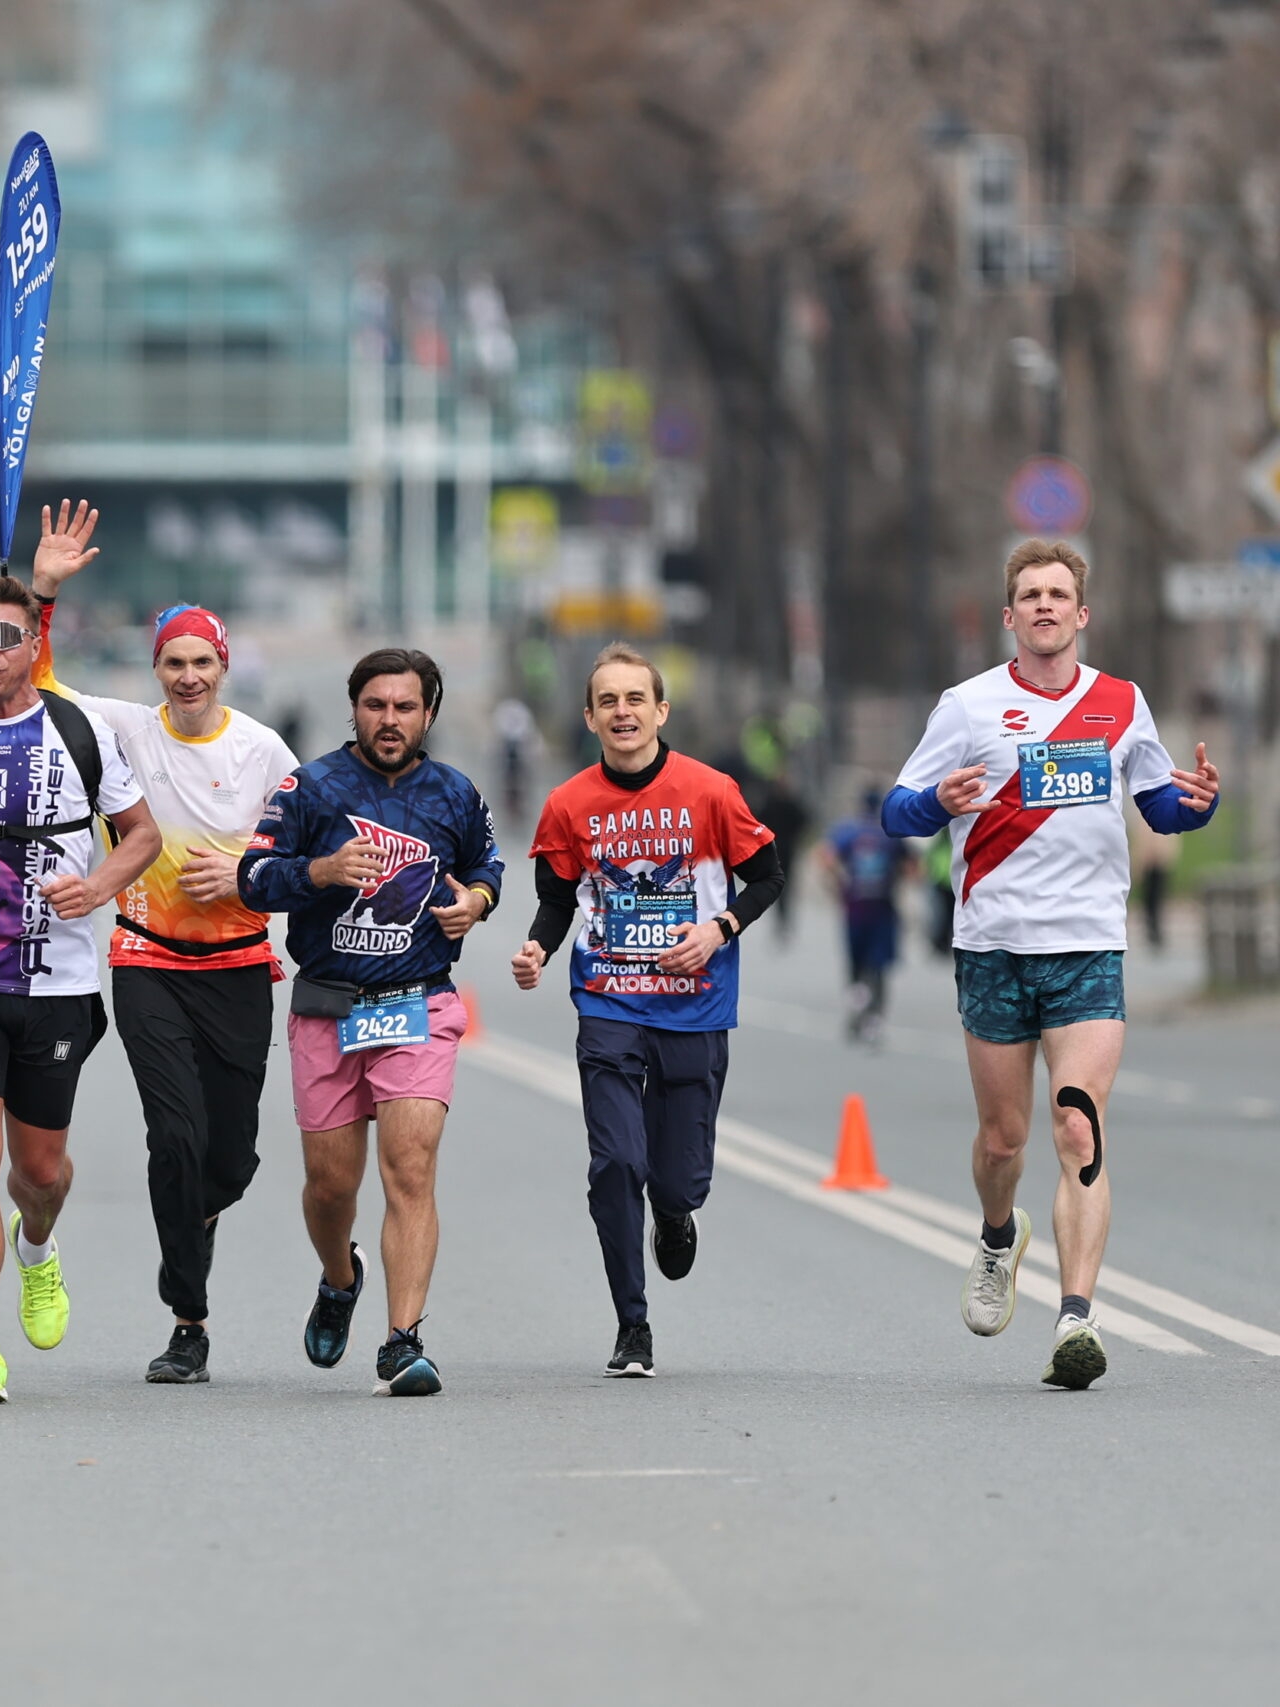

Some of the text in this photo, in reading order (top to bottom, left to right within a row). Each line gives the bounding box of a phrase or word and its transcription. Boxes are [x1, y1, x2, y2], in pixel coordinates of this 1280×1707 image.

[7, 203, 48, 288] 1:59
[9, 336, 46, 468] VOLGAMAN
[1050, 741, 1105, 750] САМАРСКИЙ
[1040, 771, 1094, 798] 2398
[589, 807, 692, 836] SAMARA
[591, 837, 693, 861] MARATHON
[640, 913, 663, 921] АНДРЕЙ
[336, 926, 409, 951] QUADRO
[624, 924, 679, 946] 2089
[592, 963, 650, 975] ПОТОМУ
[604, 976, 695, 993] ЛЮБЛЮ!
[356, 1014, 409, 1040] 2422
